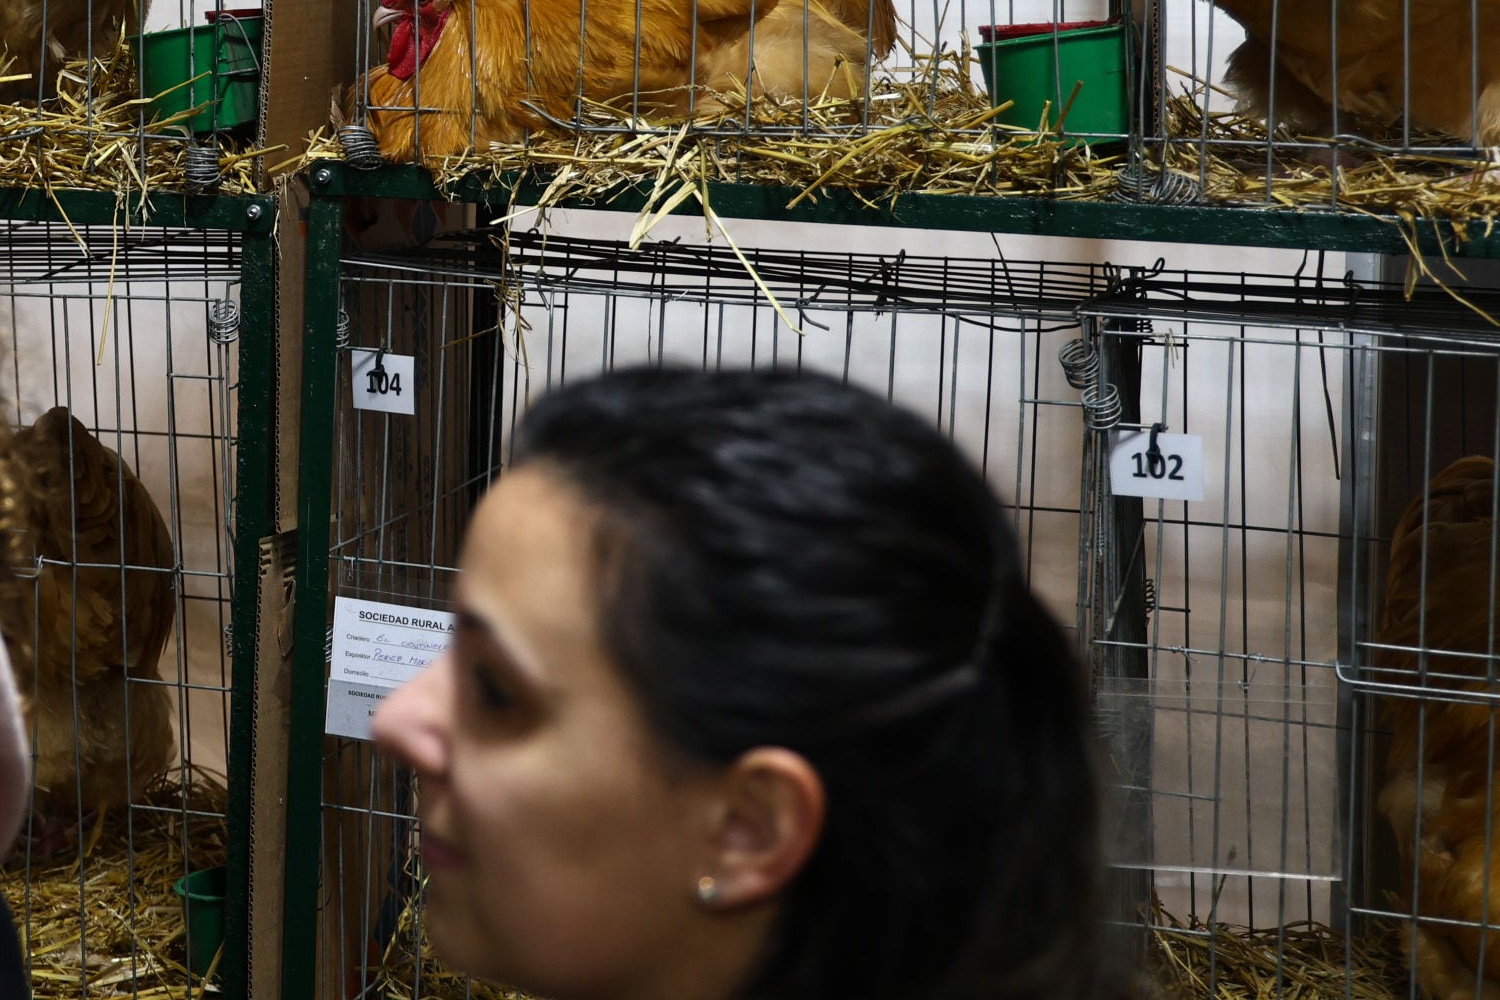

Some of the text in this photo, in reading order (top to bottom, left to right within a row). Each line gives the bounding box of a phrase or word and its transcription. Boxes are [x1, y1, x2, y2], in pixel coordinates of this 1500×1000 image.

[366, 370, 402, 396] 104
[1131, 452, 1184, 481] 102
[358, 610, 409, 625] SOCIEDAD
[411, 618, 445, 631] RURAL
[345, 650, 371, 660] Expositor
[344, 668, 369, 677] Domicilio
[348, 690, 375, 699] SOCIEDAD
